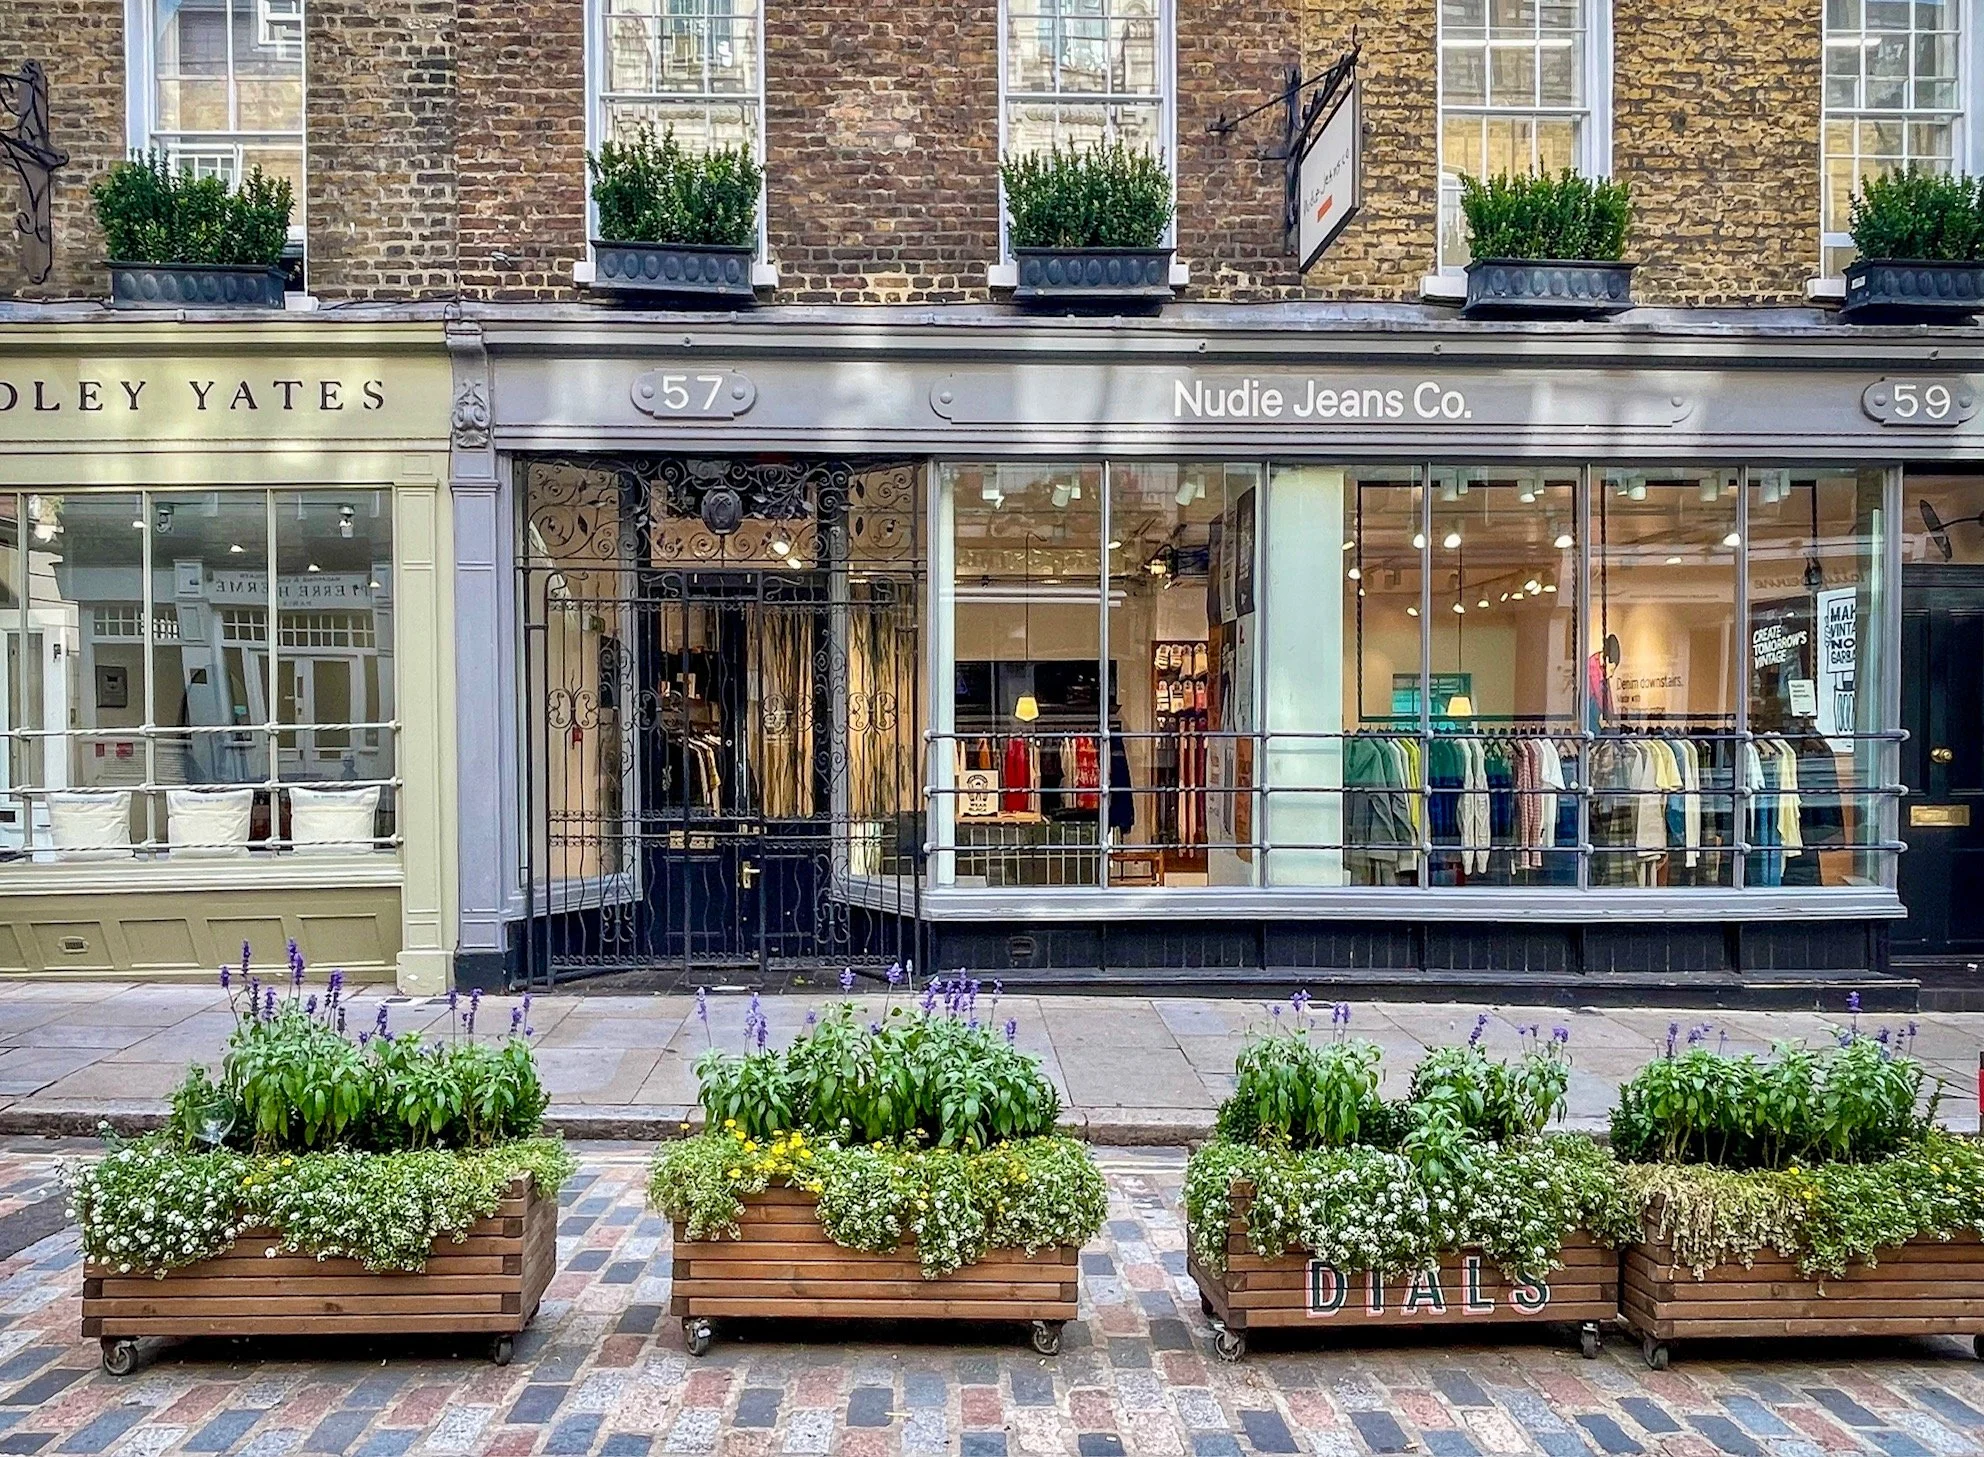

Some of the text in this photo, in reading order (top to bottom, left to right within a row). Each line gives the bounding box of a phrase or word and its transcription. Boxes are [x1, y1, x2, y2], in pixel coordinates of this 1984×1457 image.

[189, 380, 385, 411] YATES
[662, 374, 723, 410] 57
[1174, 379, 1473, 419] Nudie Jeans Co.
[1894, 384, 1951, 419] 59
[1753, 624, 1781, 645] CREATE
[1754, 648, 1787, 670] VINTAGE
[1306, 1256, 1551, 1318] DIALS
